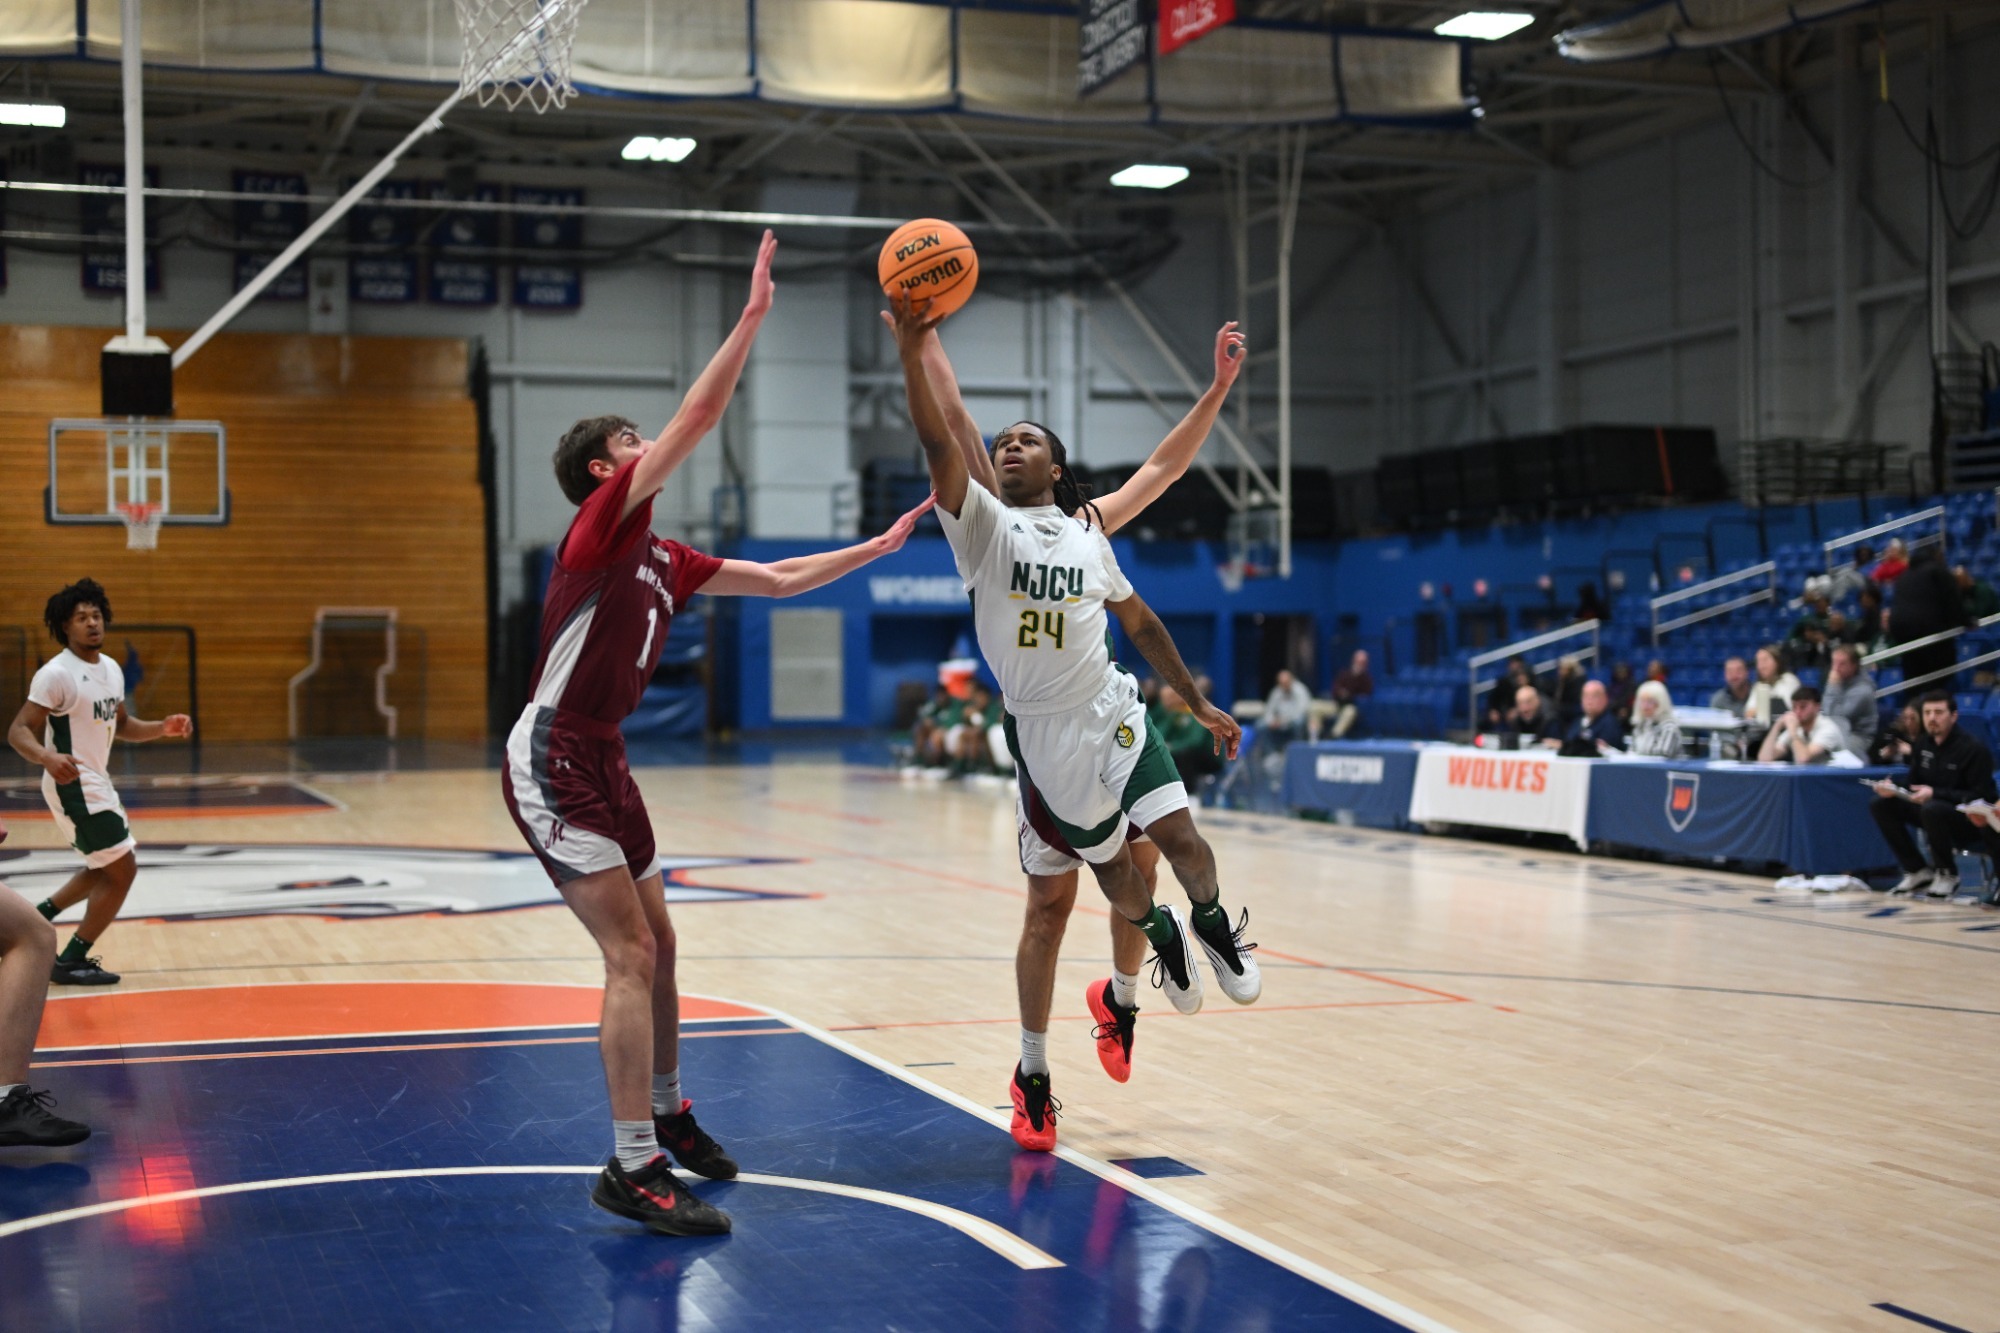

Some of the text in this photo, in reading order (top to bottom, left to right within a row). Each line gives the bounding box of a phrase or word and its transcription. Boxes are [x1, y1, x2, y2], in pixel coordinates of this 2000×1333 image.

[896, 233, 940, 262] NCAA
[900, 257, 964, 290] Wilson
[1010, 561, 1083, 601] NJCU
[635, 607, 658, 670] 1
[1017, 608, 1064, 650] 24
[1448, 756, 1549, 794] WOLVES
